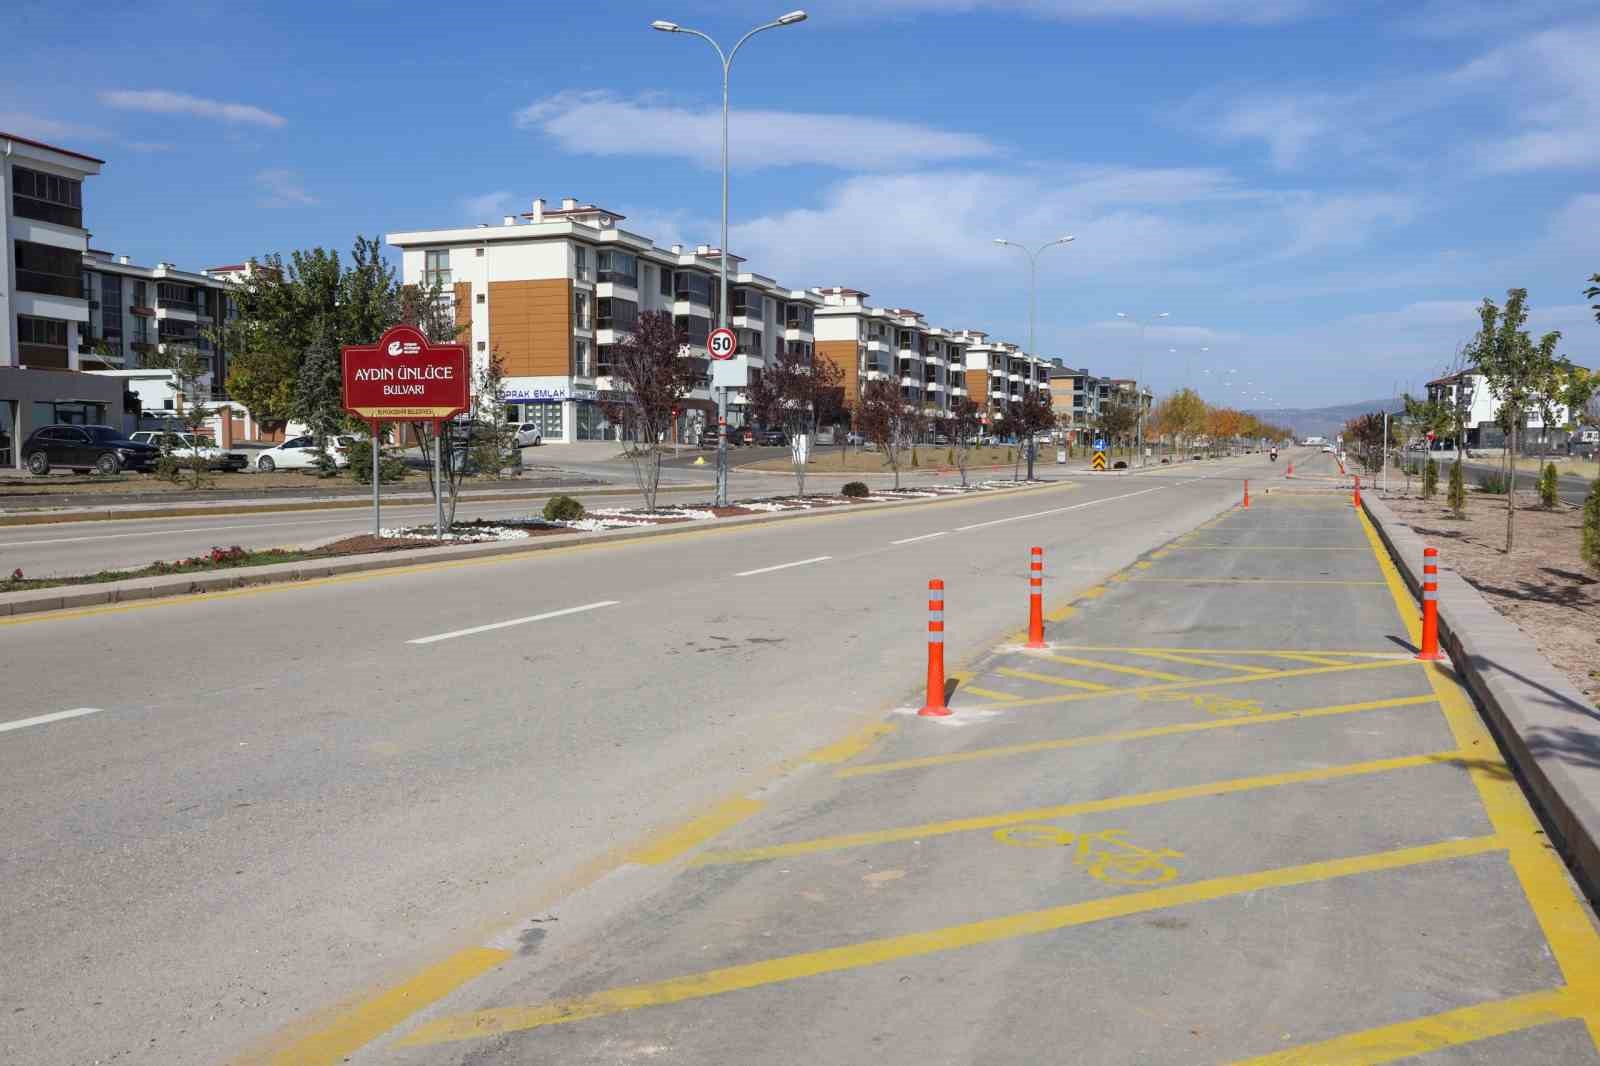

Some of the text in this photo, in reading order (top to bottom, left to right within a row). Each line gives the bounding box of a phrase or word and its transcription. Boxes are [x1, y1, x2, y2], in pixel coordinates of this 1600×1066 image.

[713, 338, 730, 350] 50
[355, 364, 454, 380] AYDIN ÜNLÜCE
[383, 384, 425, 395] BULVARI
[534, 390, 566, 398] EMLAK
